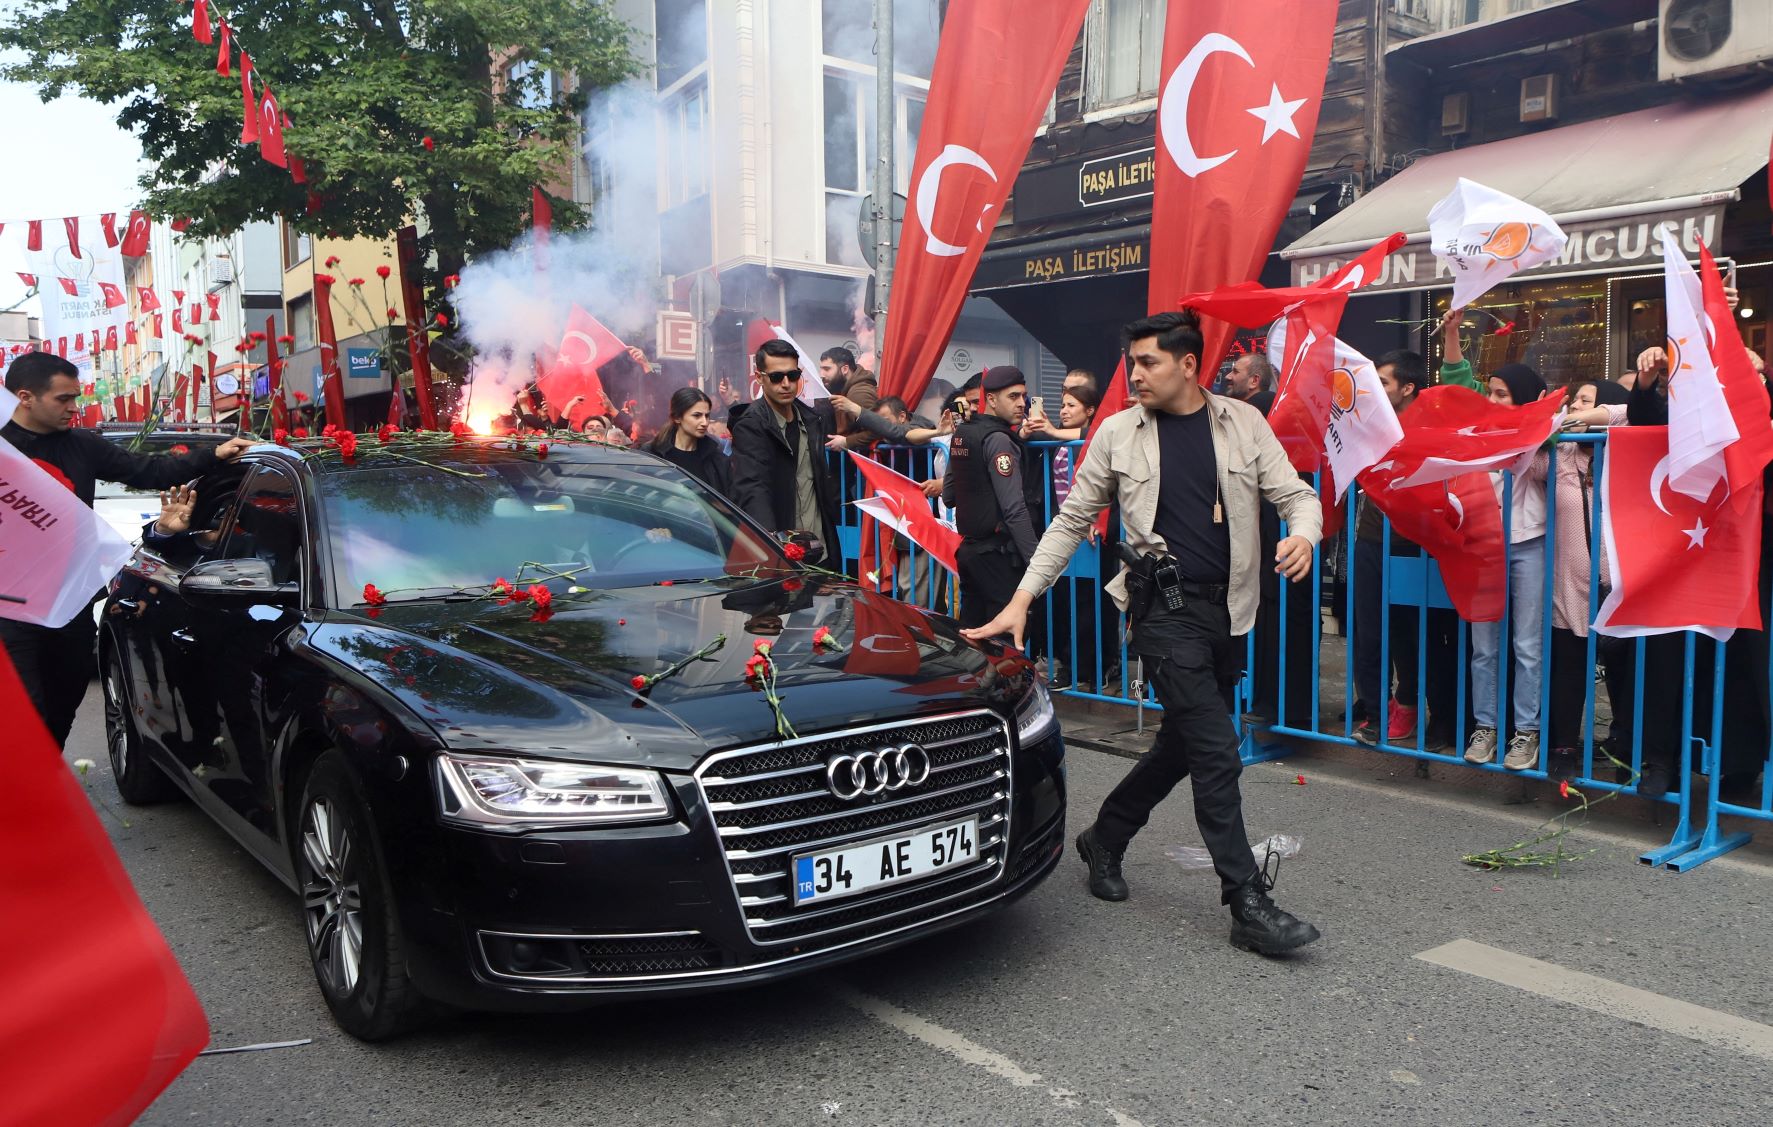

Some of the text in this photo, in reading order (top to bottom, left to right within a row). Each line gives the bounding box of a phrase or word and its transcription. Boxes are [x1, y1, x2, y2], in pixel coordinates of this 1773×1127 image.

[1083, 171, 1115, 196] PAŞA
[1025, 243, 1141, 281] PAŞA İLETİŞİM
[1436, 215, 1716, 279] KMCUSU
[670, 321, 693, 351] E
[799, 824, 972, 893] TR 34 AE 574
